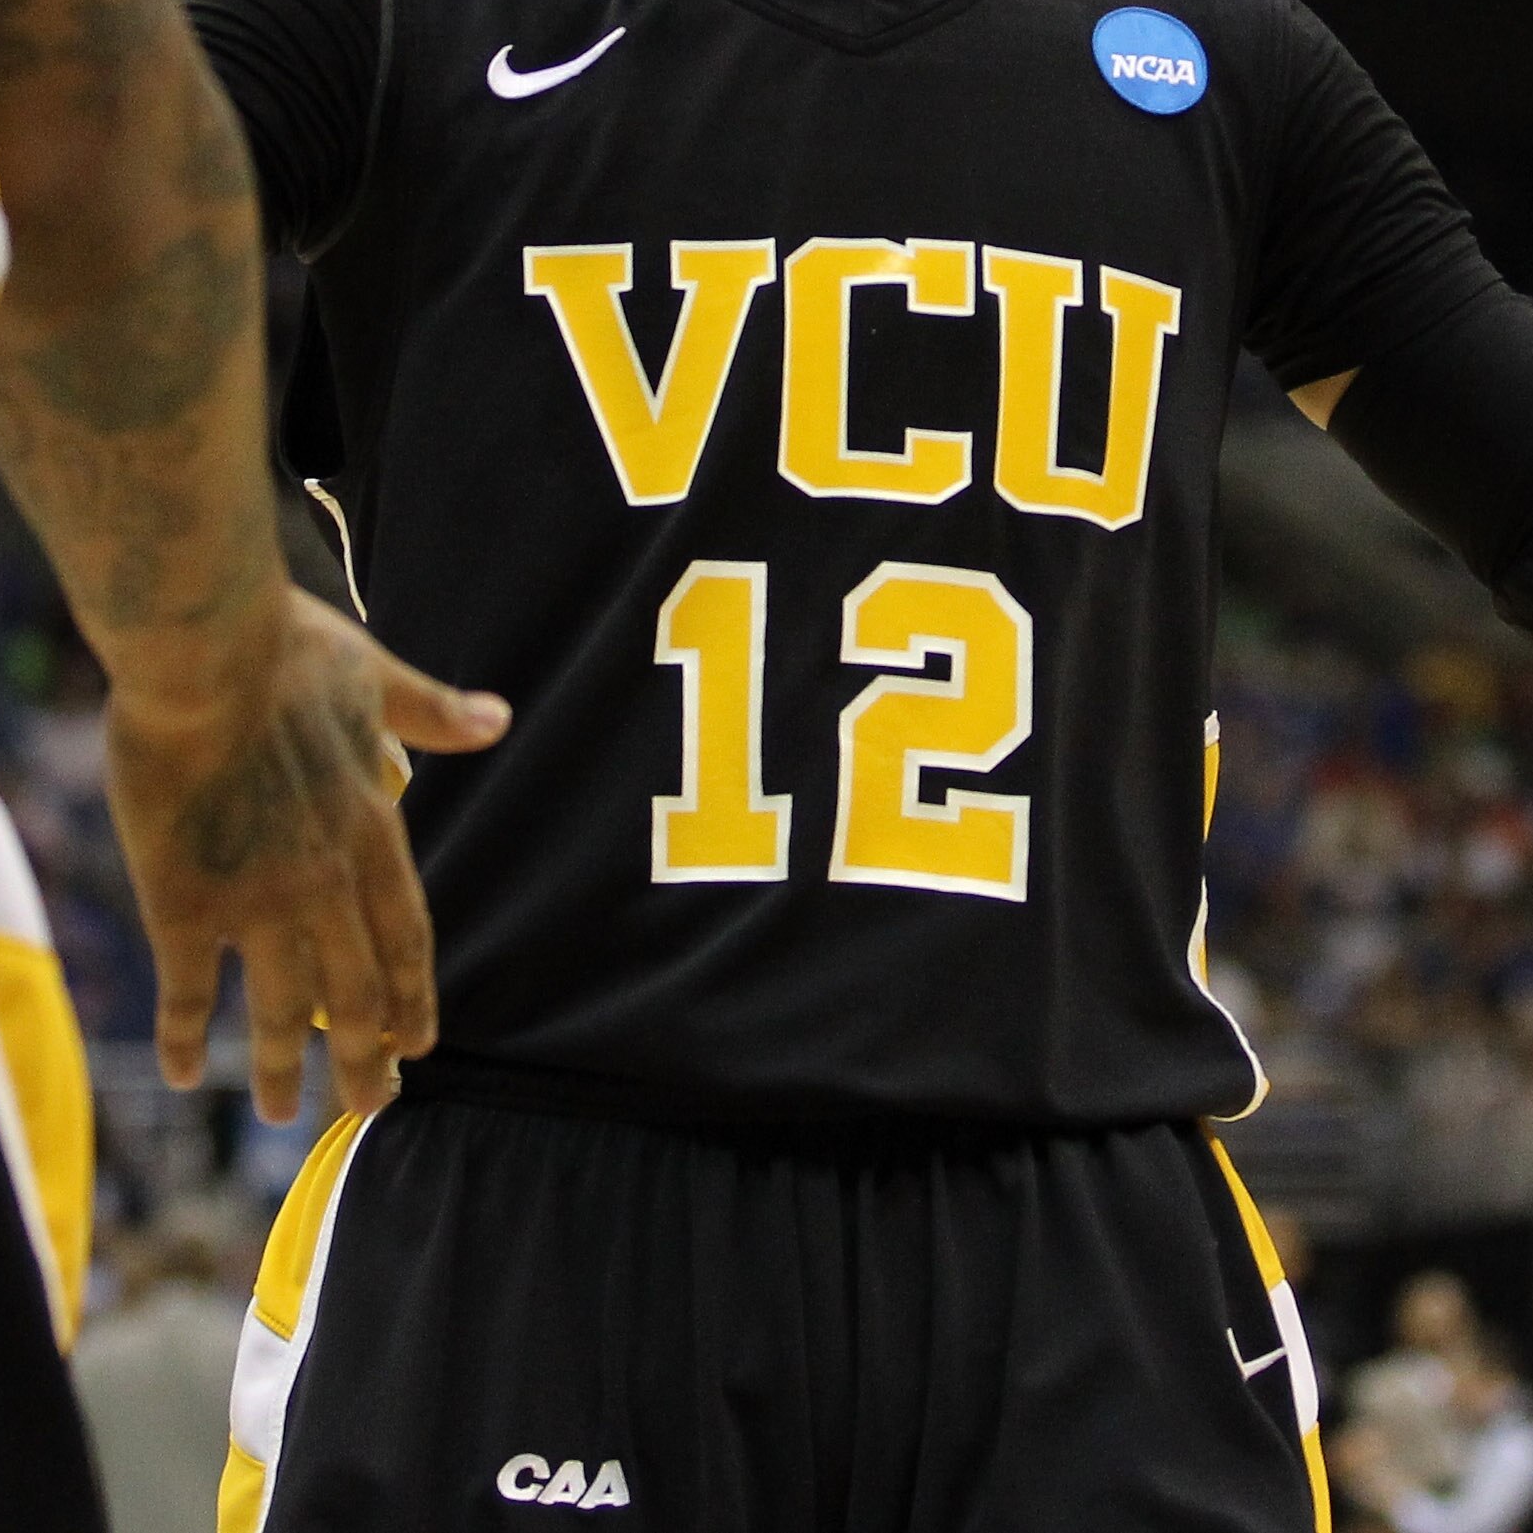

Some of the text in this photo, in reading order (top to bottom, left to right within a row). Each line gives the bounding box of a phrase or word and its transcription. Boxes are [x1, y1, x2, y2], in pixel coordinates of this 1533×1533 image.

[1111, 53, 1197, 87] NCAA
[521, 235, 1184, 533] VCU
[649, 558, 1035, 904] 12
[495, 1452, 632, 1510] CAA
